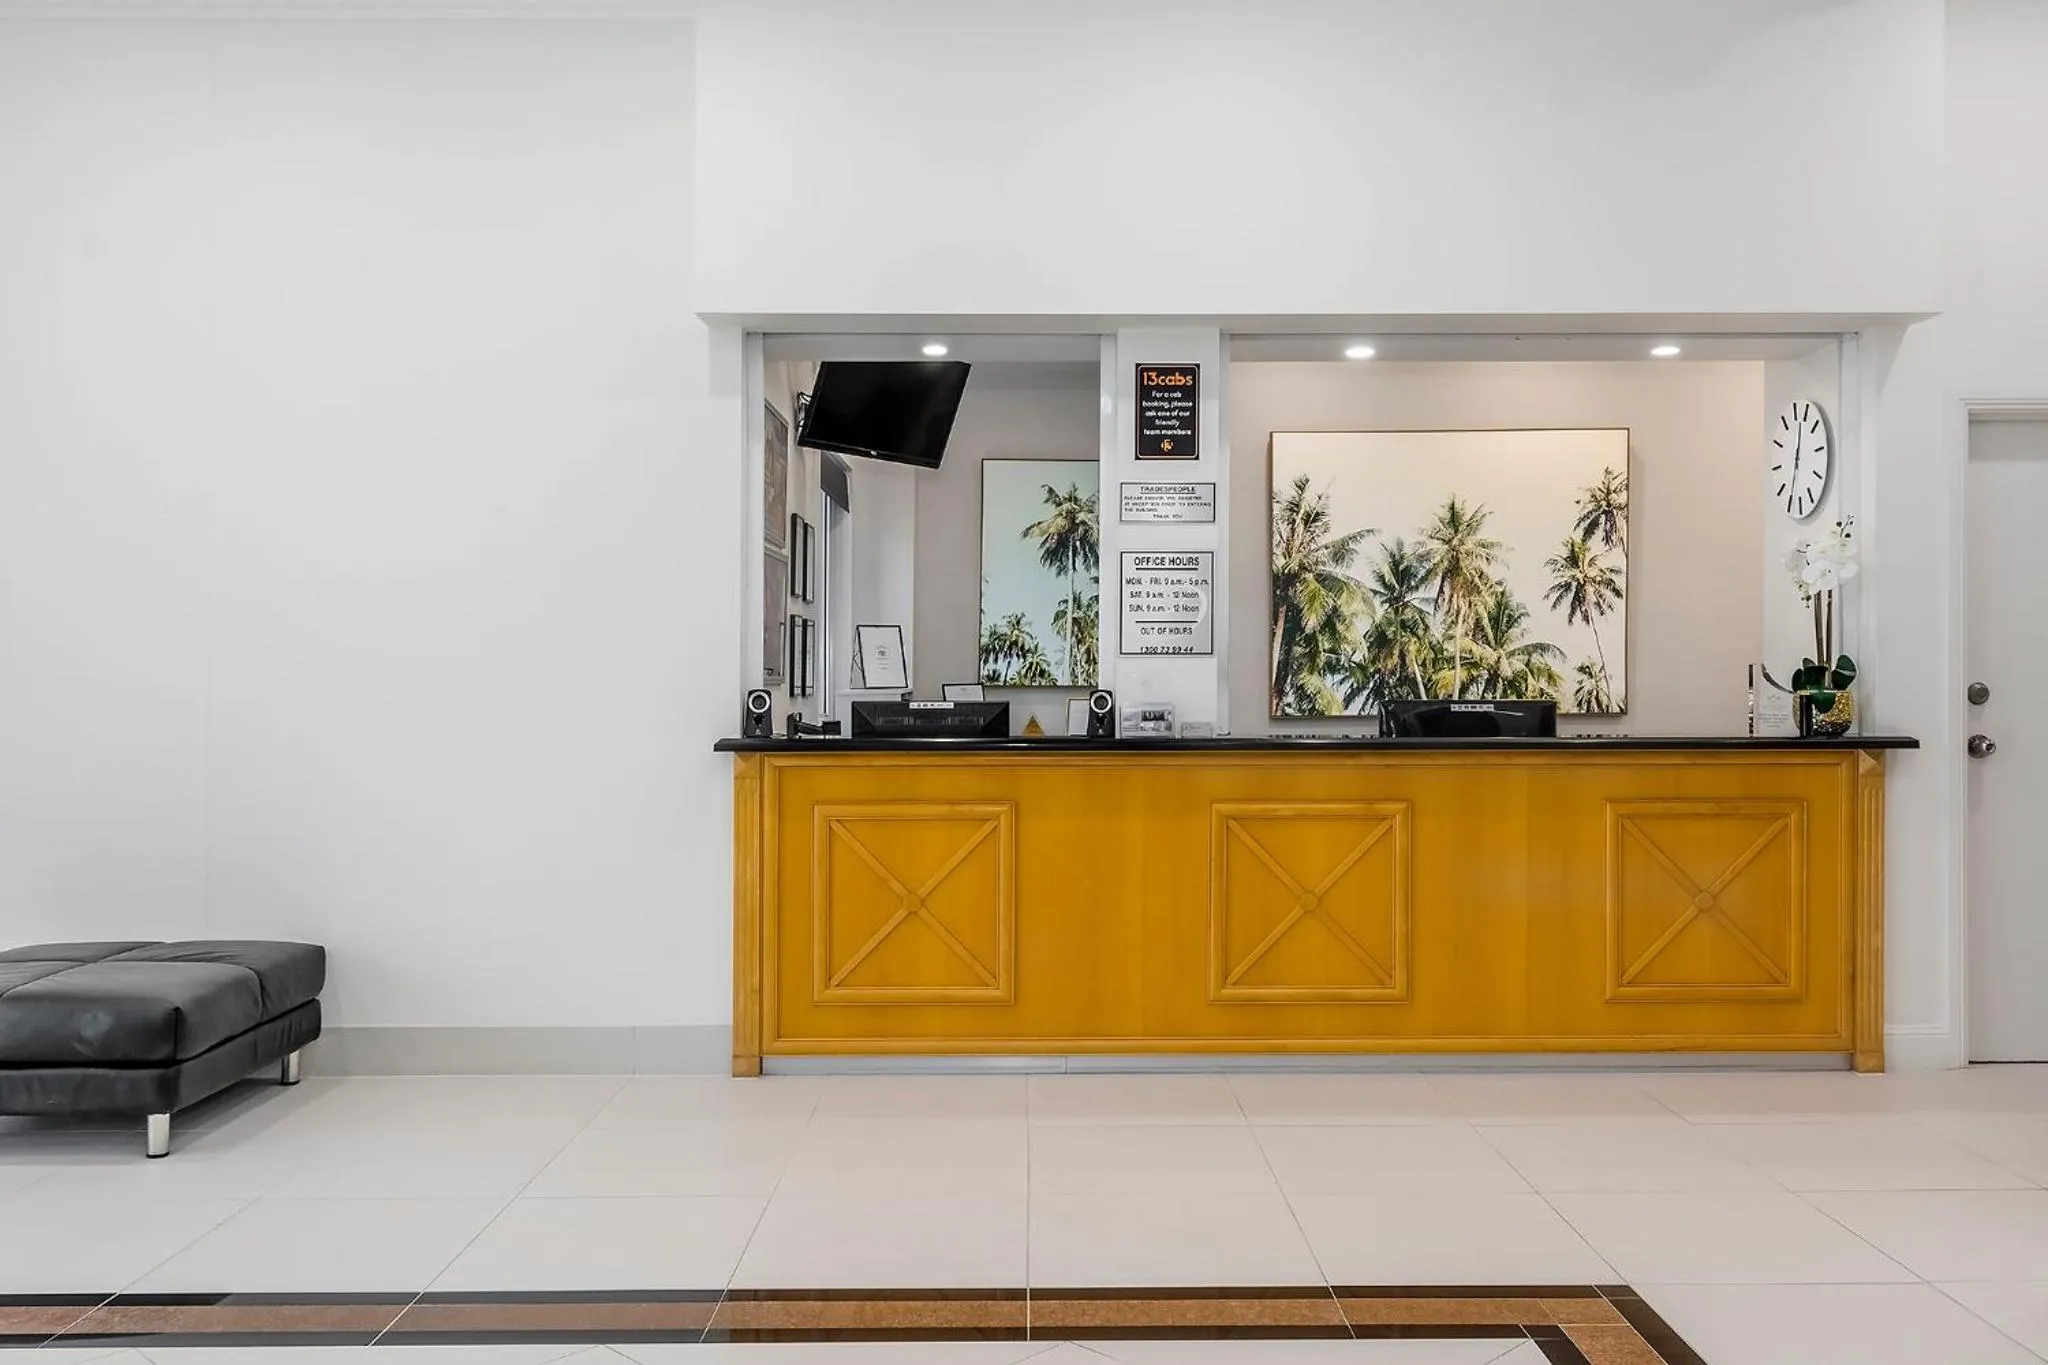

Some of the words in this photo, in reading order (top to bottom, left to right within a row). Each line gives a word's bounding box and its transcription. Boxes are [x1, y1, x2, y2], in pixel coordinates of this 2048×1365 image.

[1143, 372, 1193, 386] 13cabs
[1142, 400, 1170, 408] booking,
[1171, 400, 1193, 408] please
[1155, 419, 1180, 427] friendly
[1134, 556, 1166, 566] OFFICE
[1168, 556, 1200, 566] HOURS
[1173, 604, 1180, 612] 12
[1182, 604, 1199, 612] Noon
[1140, 627, 1154, 635] OUT
[1157, 627, 1166, 635] OF
[1168, 627, 1193, 635] HOURS
